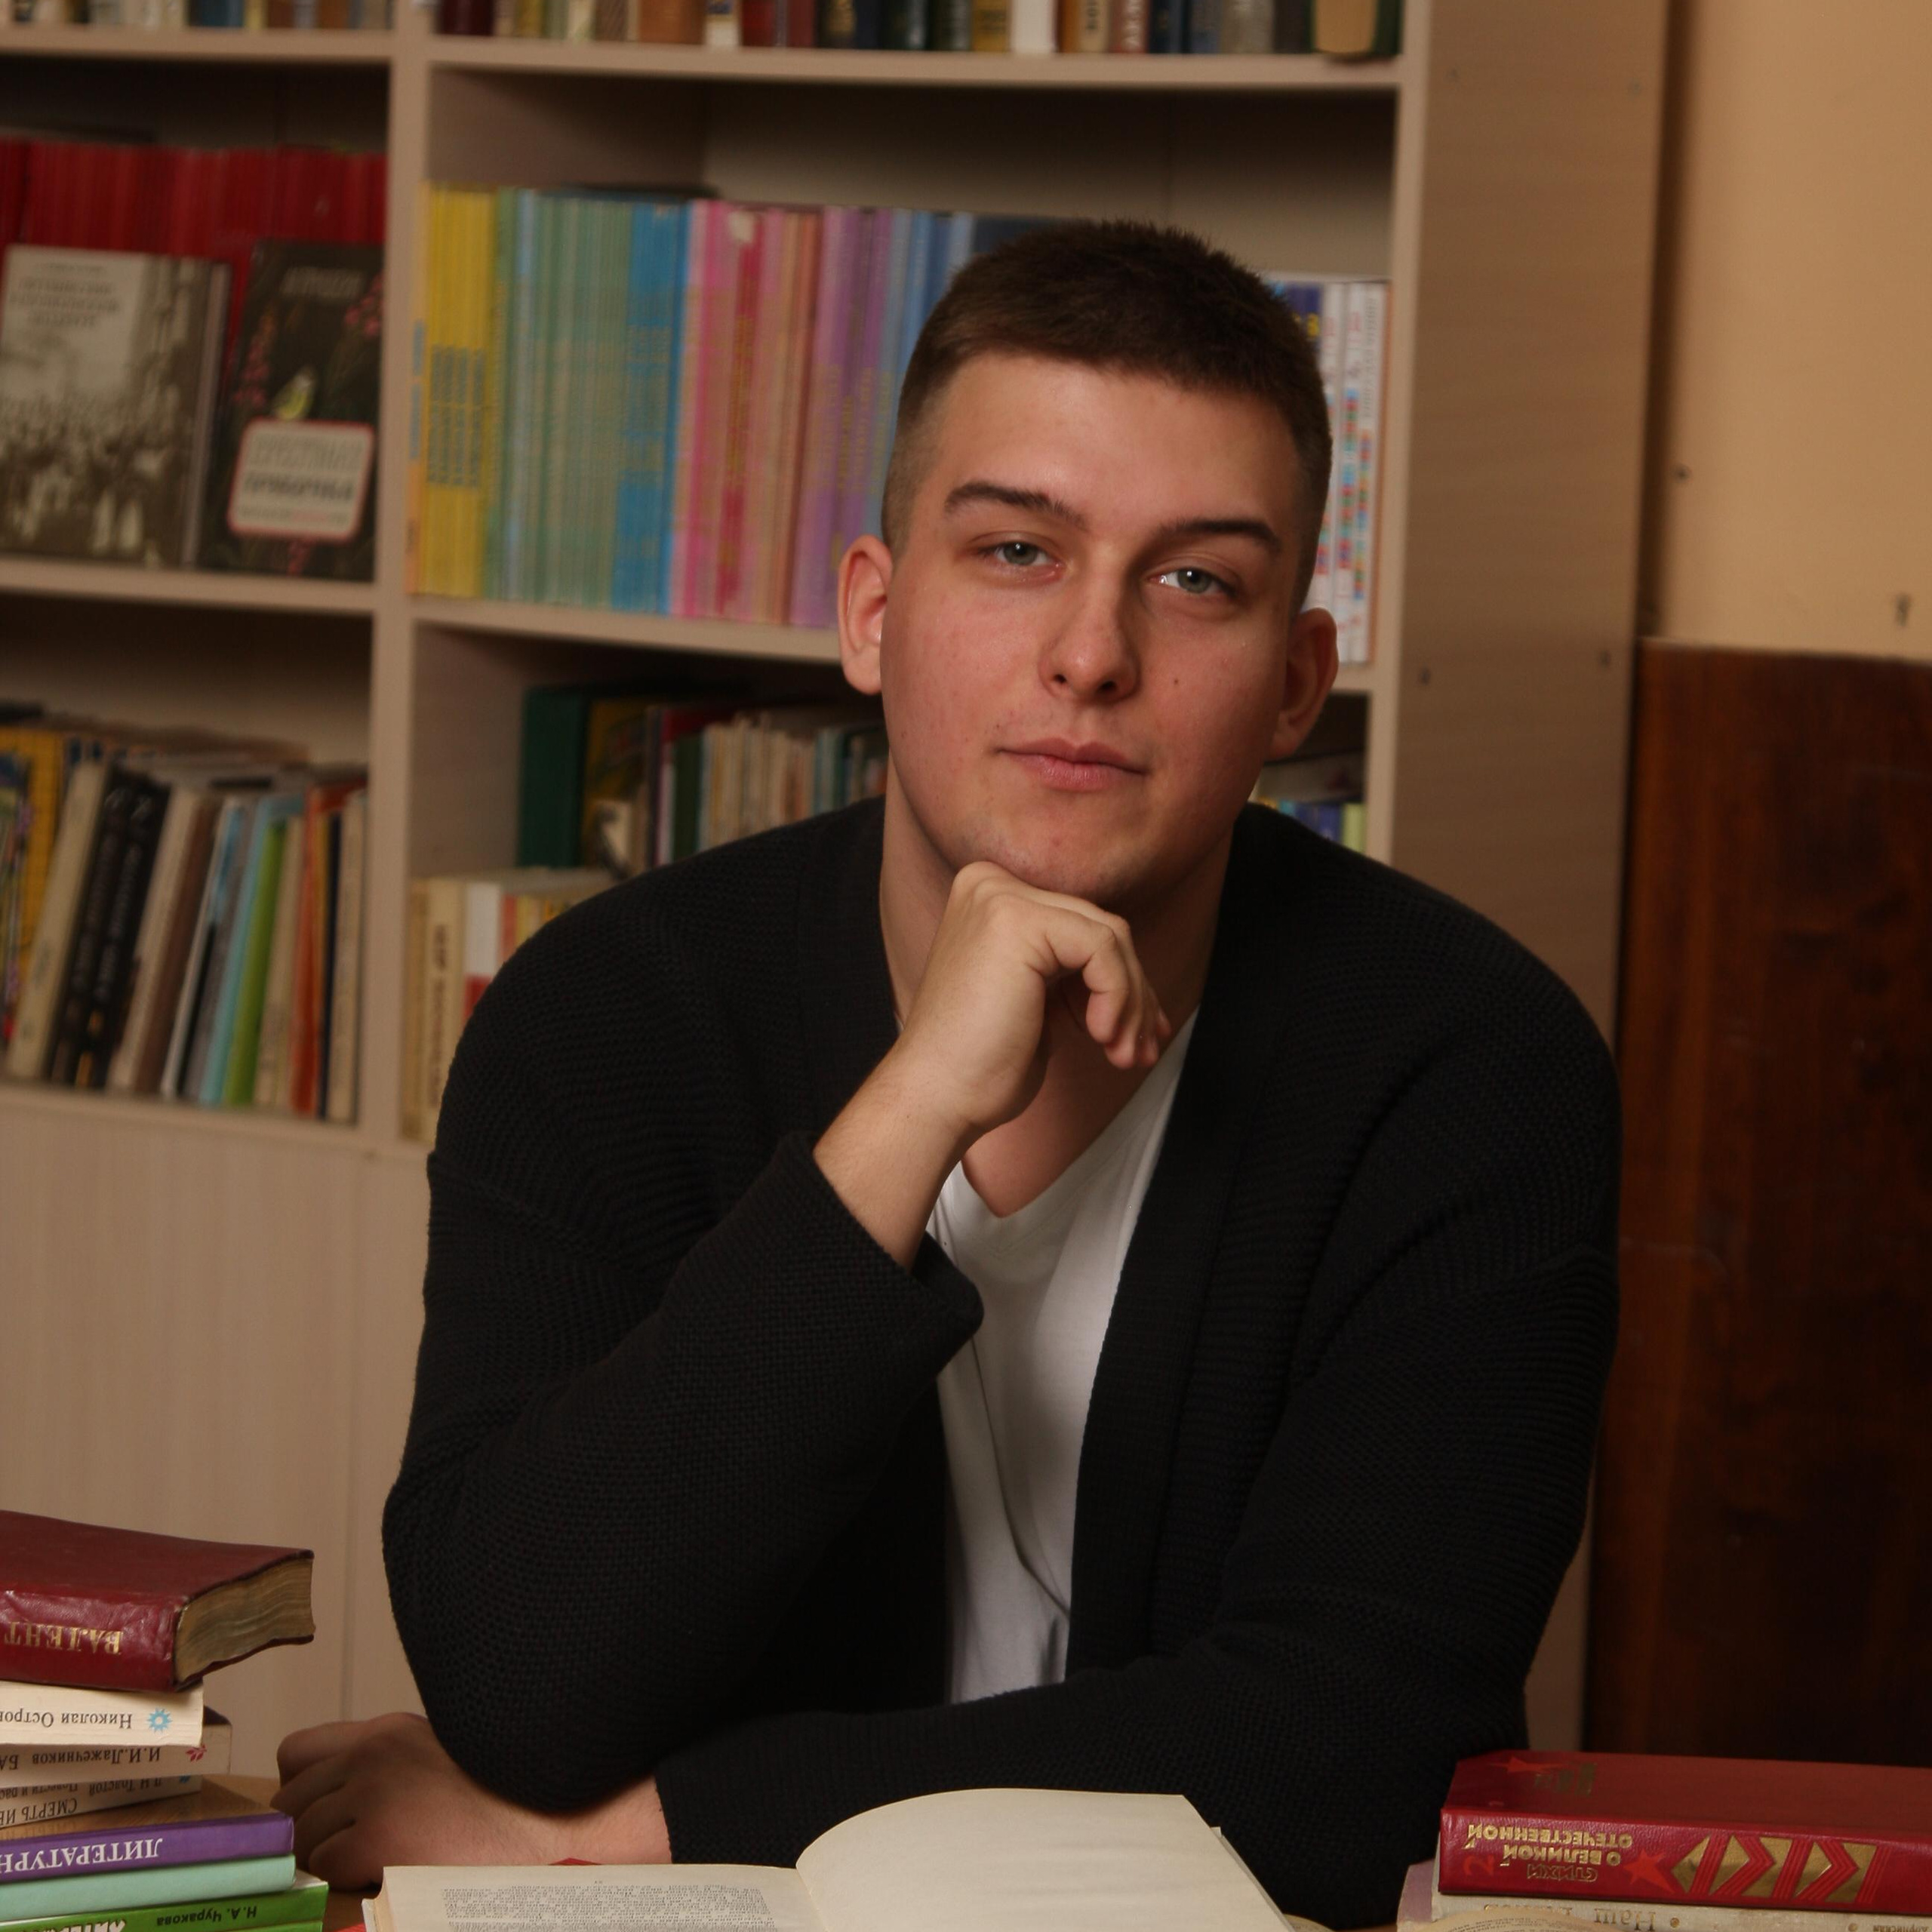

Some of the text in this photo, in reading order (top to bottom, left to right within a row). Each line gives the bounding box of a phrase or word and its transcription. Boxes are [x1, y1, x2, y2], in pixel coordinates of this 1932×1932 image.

[4, 1622, 124, 1654] ВАЛЕНТ
[22, 1798, 78, 1821] СМЕРТЬ
[1463, 1823, 1633, 1849] ОТЕЧЕСТВЕННОЙ
[0, 1838, 163, 1873] ЛИТЕРАТУРН
[1500, 1843, 1621, 1866] О ВЕЛИКОЙ
[1527, 1863, 1598, 1882] СТИХИ
[156, 1908, 222, 1925] Чуракова
[1594, 1908, 1656, 1931] Наш
